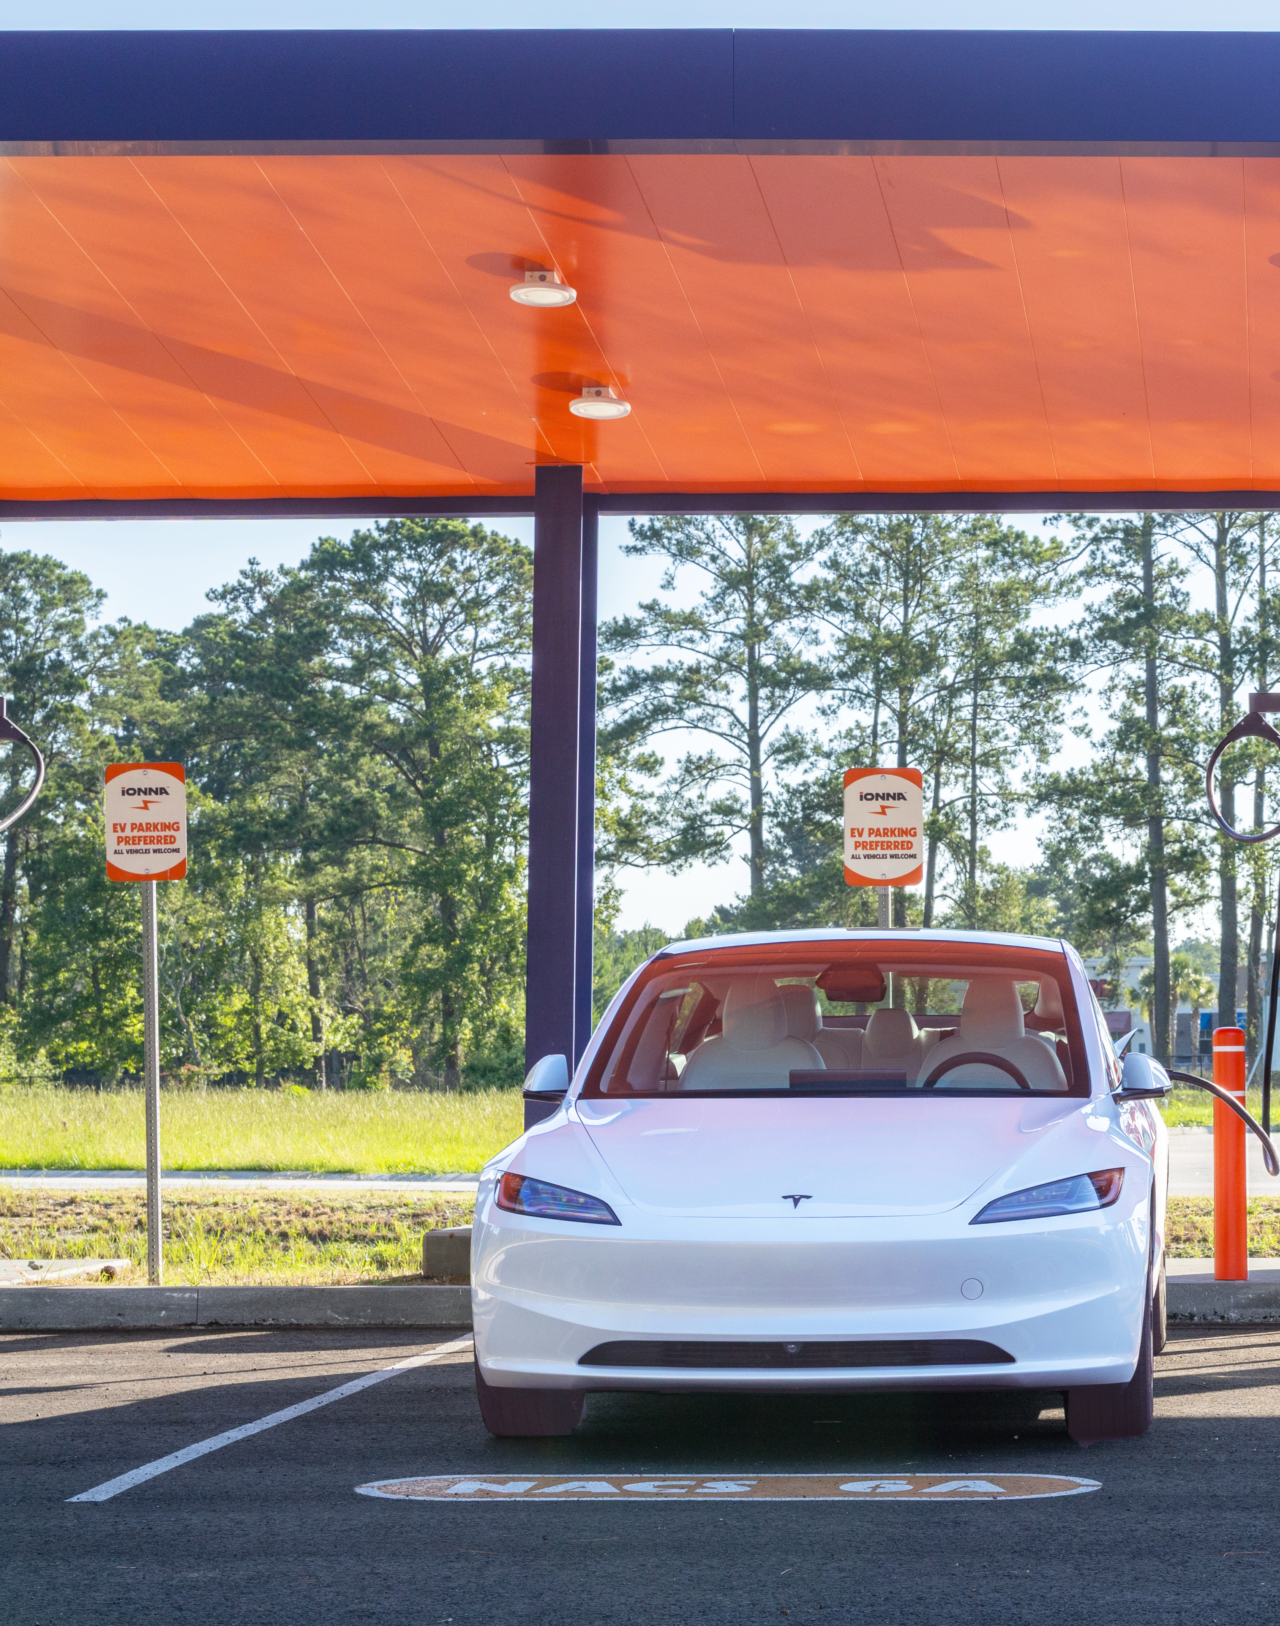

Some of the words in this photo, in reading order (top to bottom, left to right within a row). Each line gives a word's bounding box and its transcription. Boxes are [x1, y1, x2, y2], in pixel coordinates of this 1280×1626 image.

[112, 823, 127, 833] EV
[130, 821, 180, 833] PARKING
[850, 827, 865, 838] EV
[868, 827, 917, 838] PARKING
[116, 835, 177, 846] PREFERRED
[854, 840, 914, 851] PREFERRED
[445, 1480, 759, 1493] NACS
[839, 1480, 1007, 1493] 6A
